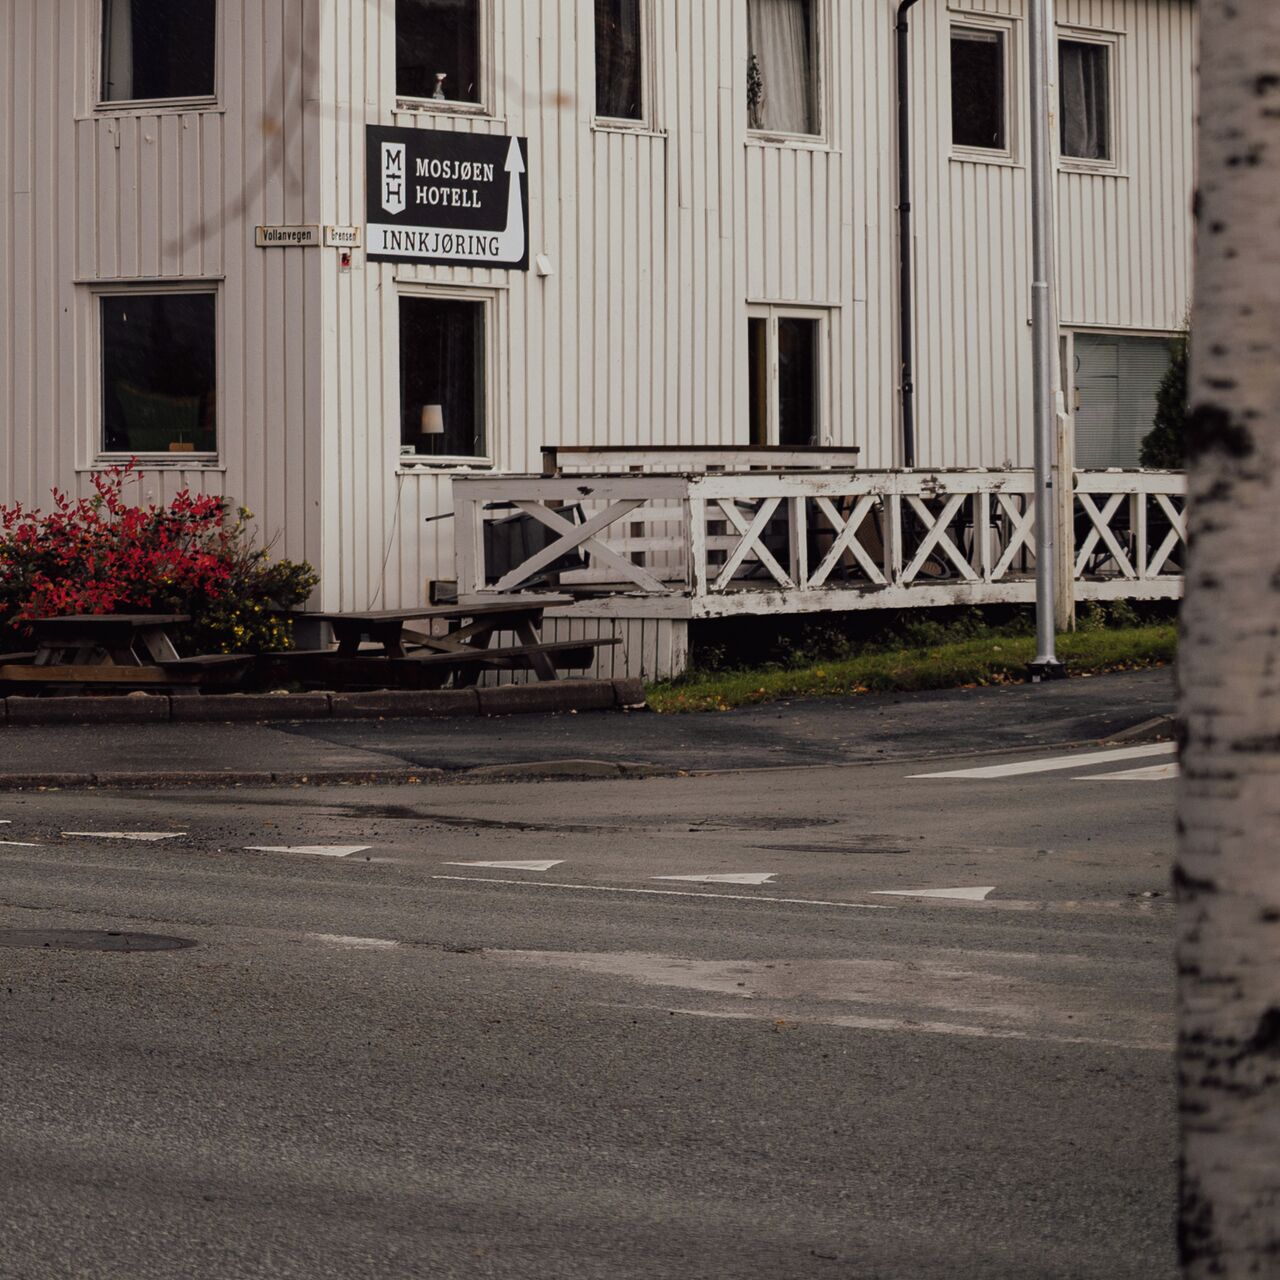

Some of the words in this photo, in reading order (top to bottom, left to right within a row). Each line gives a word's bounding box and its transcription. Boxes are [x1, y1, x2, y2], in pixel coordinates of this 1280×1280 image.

[415, 158, 494, 183] MOSJØEN
[415, 185, 482, 209] HOTELL
[262, 229, 312, 244] Vollanvegen
[382, 229, 500, 257] INNKJØRING
